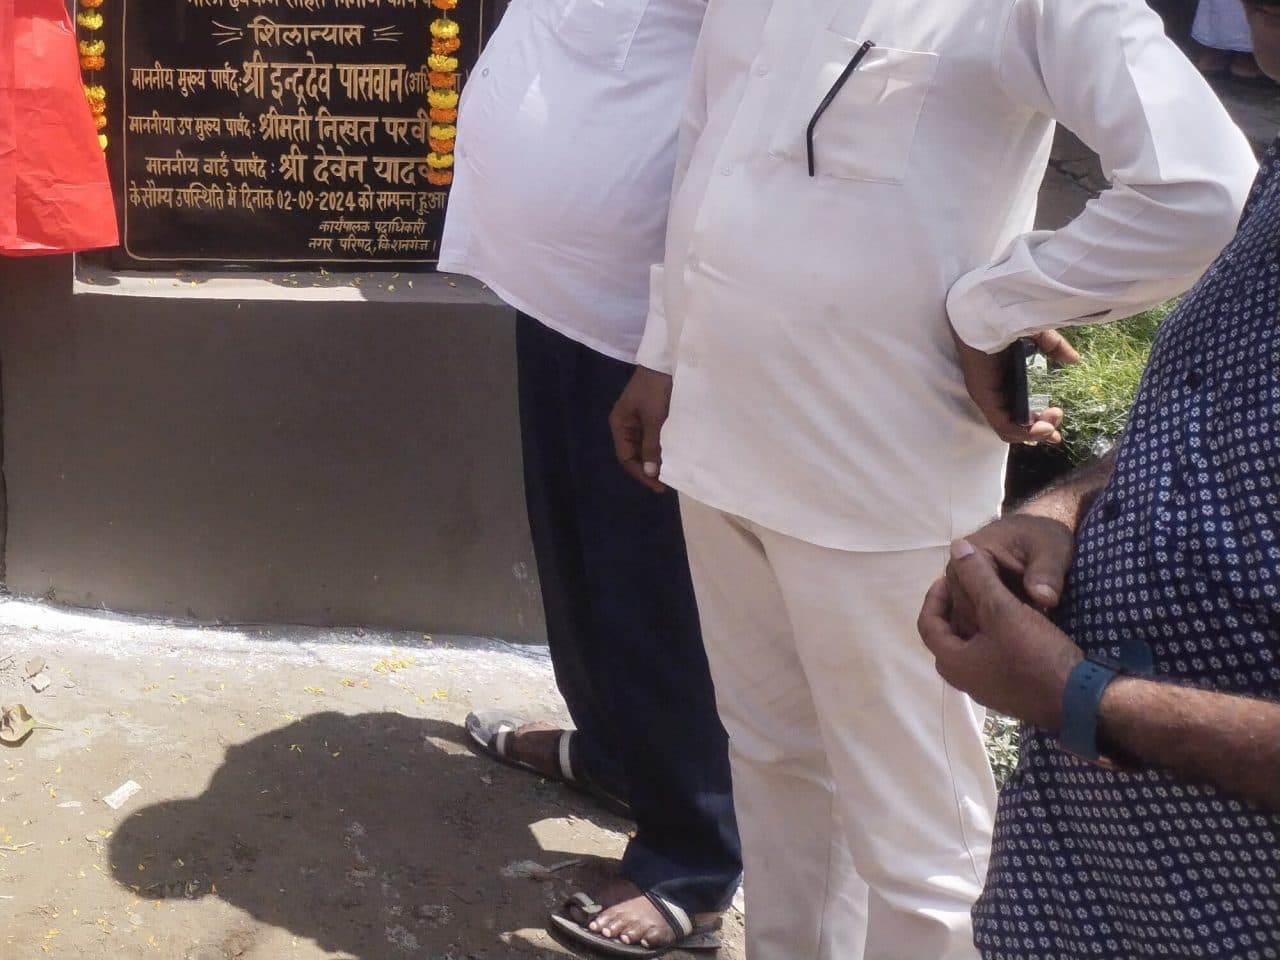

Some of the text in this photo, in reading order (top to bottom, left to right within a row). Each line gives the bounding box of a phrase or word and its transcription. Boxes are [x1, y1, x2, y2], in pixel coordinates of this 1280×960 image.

[247, 15, 365, 47] शिलान्यास
[131, 60, 175, 90] माननीय
[176, 68, 207, 98] मुख्य
[242, 49, 269, 99] श्री
[336, 63, 406, 103] पासवान
[128, 110, 176, 135] माननीया
[176, 117, 193, 135] उप
[194, 117, 220, 141] मुख्य
[259, 105, 313, 143] श्रीमती
[382, 108, 433, 145] परवी
[145, 149, 199, 176] माननीय
[203, 151, 230, 178] वार्ड
[279, 144, 308, 183] श्री
[314, 144, 367, 184] देवेन
[175, 182, 224, 209] उपस्थिति
[239, 182, 274, 213] दिनांक
[276, 191, 356, 211] 02-09-2024
[357, 184, 373, 212] को
[376, 192, 416, 212] सम्पन्न
[319, 216, 427, 235] कार्यपालक पदाधिकारी
[308, 238, 333, 253] नगर
